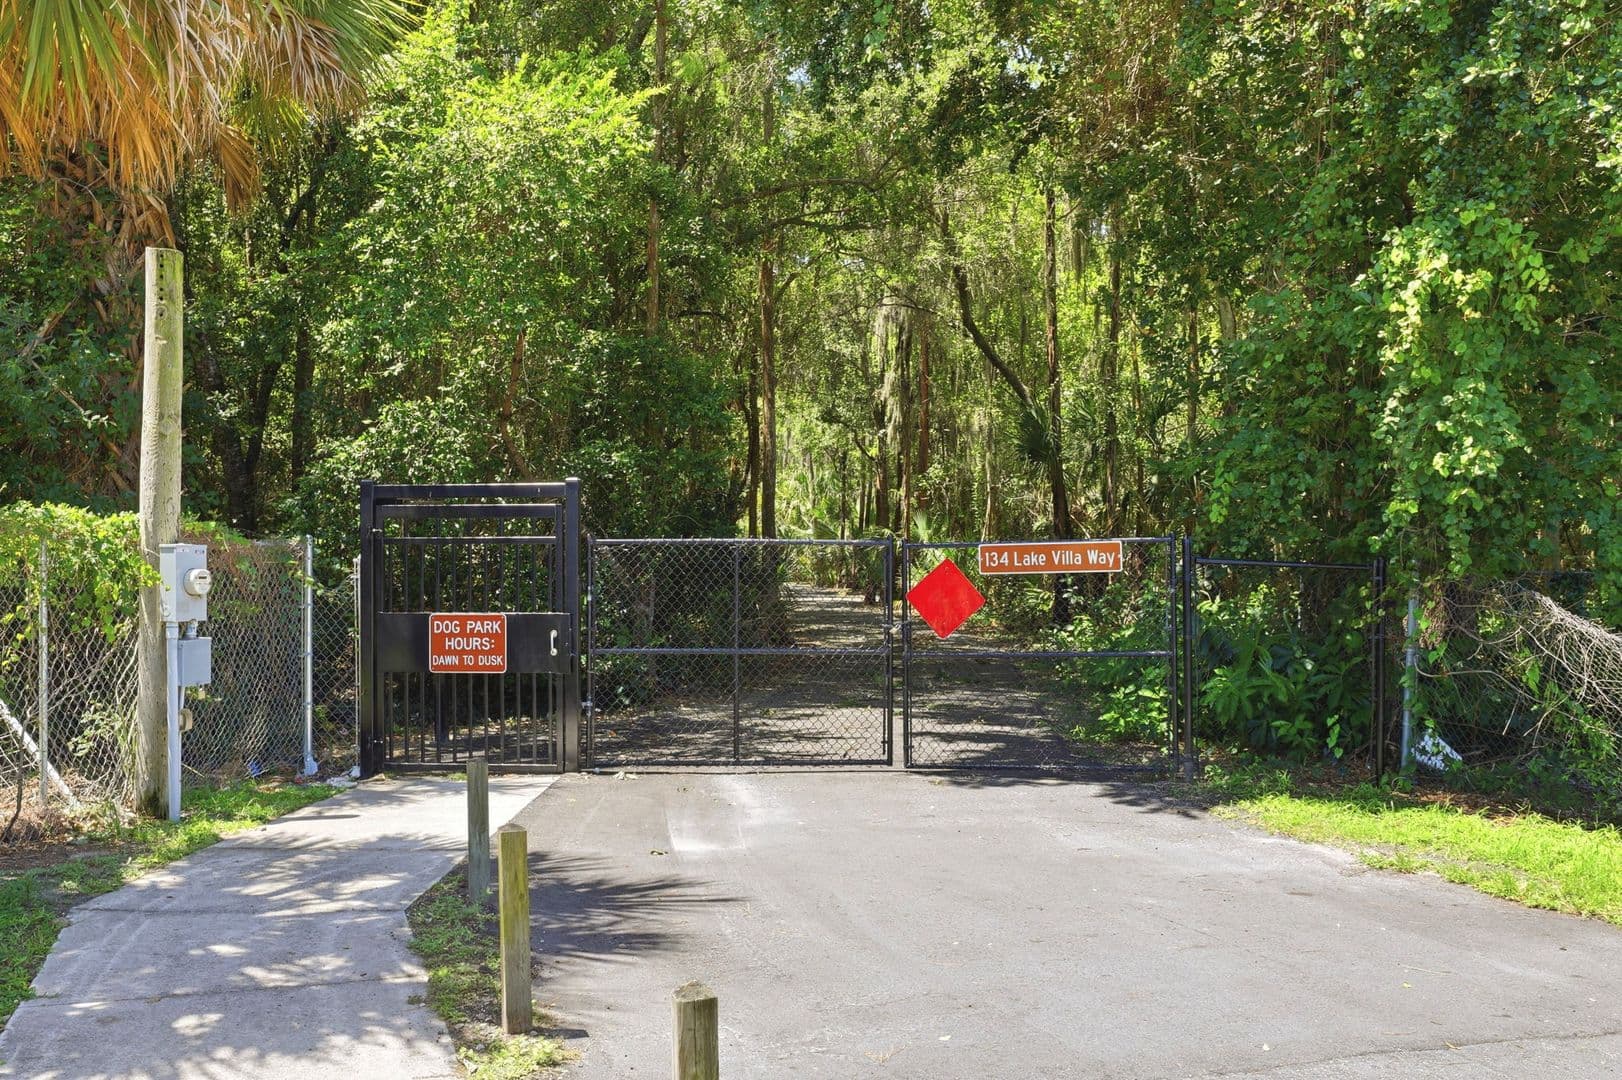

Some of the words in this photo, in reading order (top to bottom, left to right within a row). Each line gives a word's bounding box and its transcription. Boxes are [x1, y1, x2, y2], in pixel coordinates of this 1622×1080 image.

[985, 551, 1009, 567] 134
[1014, 551, 1046, 567] Lake
[1052, 550, 1082, 566] Villa
[1087, 549, 1115, 567] Way
[433, 620, 460, 634] DOG
[466, 620, 502, 634] PARK
[445, 637, 495, 650] HOURS:
[432, 655, 459, 666] DAWN
[463, 655, 474, 666] TO
[478, 655, 503, 666] DUSK
